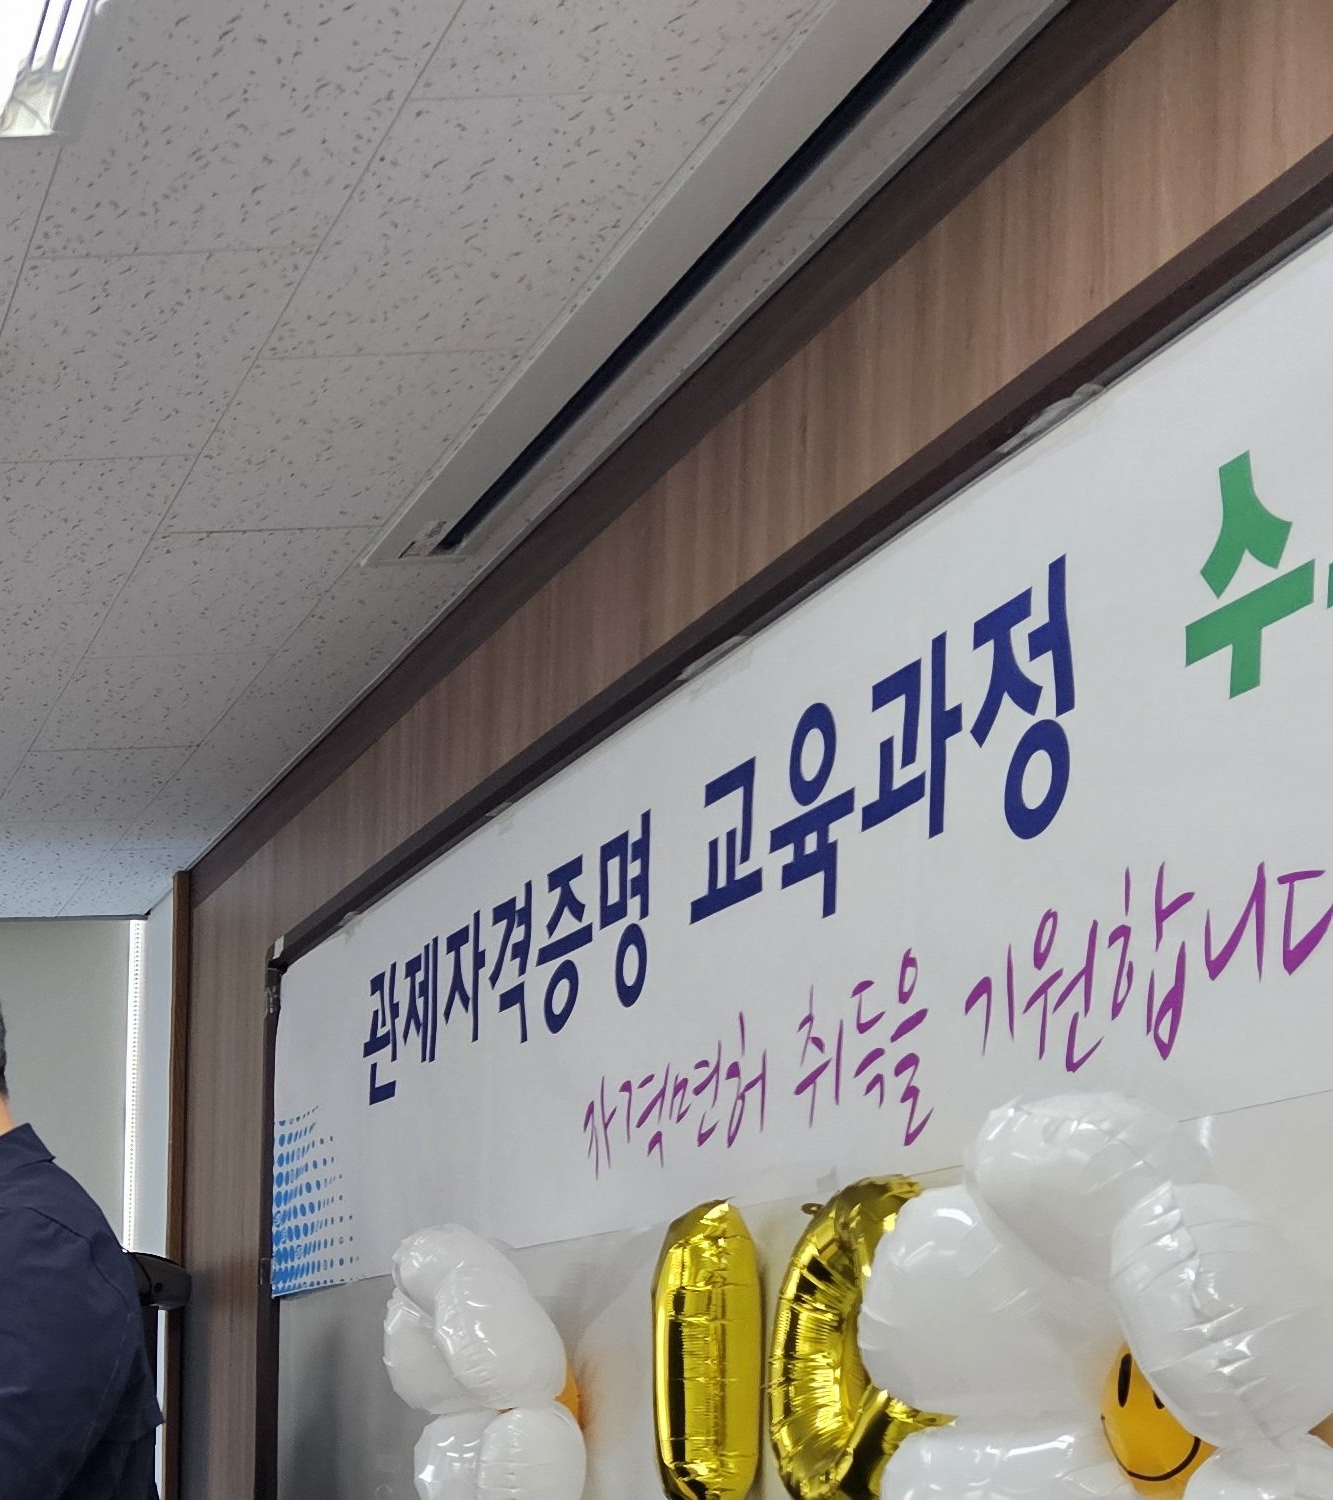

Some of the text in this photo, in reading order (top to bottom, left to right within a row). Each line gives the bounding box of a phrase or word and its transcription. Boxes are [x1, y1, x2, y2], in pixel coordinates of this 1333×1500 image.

[363, 449, 1333, 1105] 관제자격증명 교육과정 수
[583, 1010, 767, 1181] 자격면허
[793, 946, 935, 1147] 취득을
